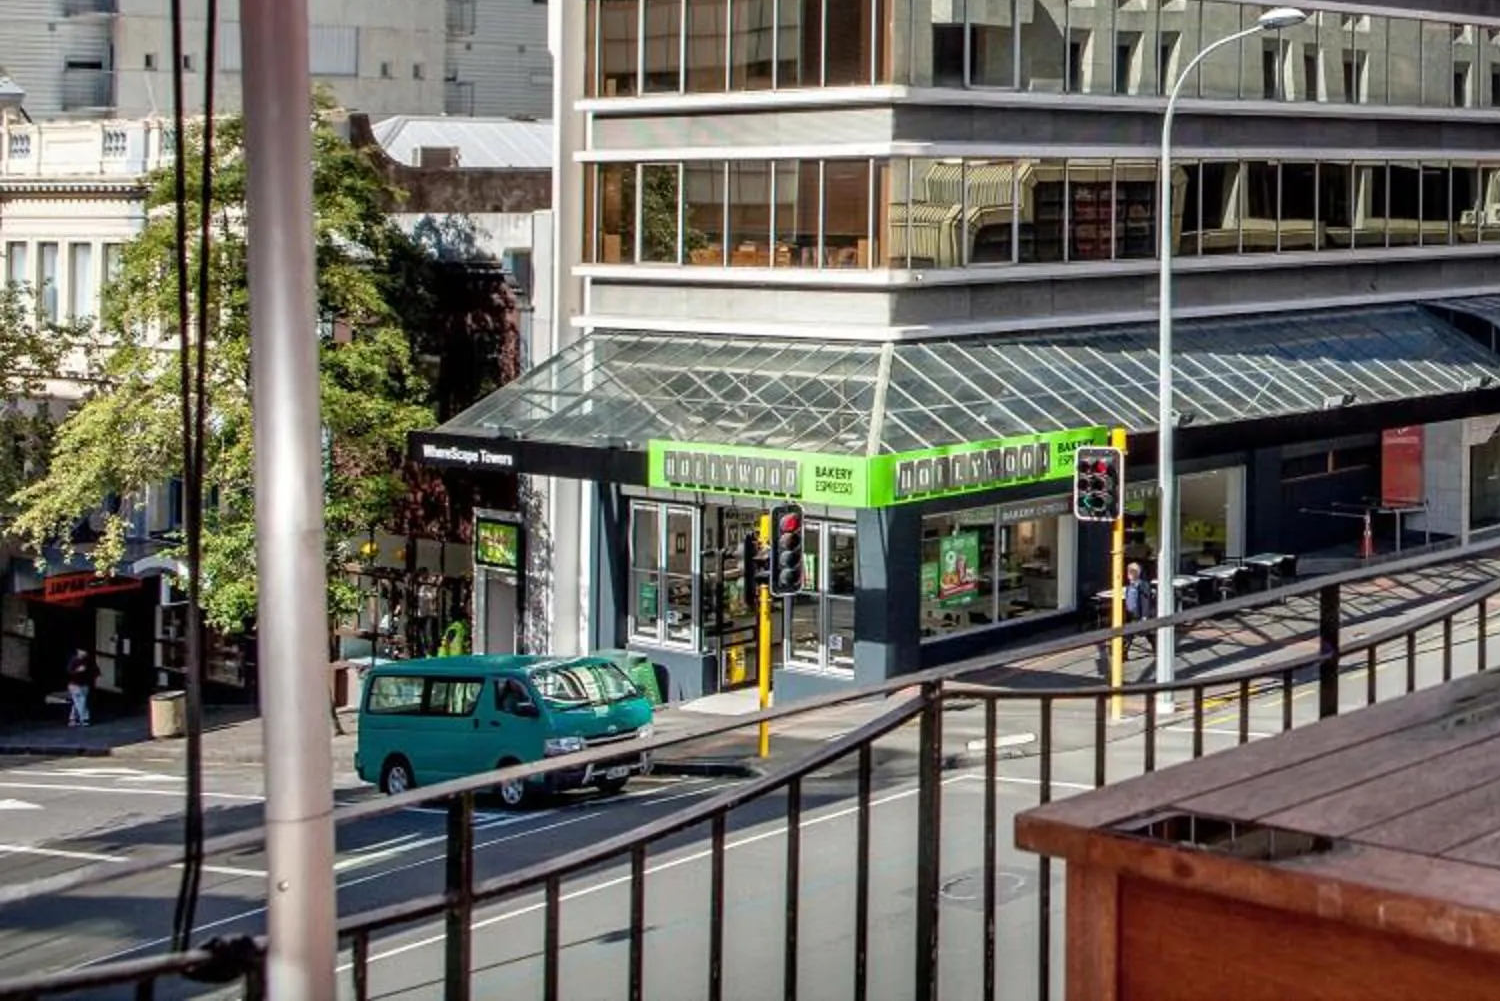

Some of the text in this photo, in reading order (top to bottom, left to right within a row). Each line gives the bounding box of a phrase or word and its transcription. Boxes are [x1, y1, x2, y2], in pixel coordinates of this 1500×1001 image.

[423, 444, 513, 465] WhereScape Towers
[815, 465, 853, 480] BAKERY
